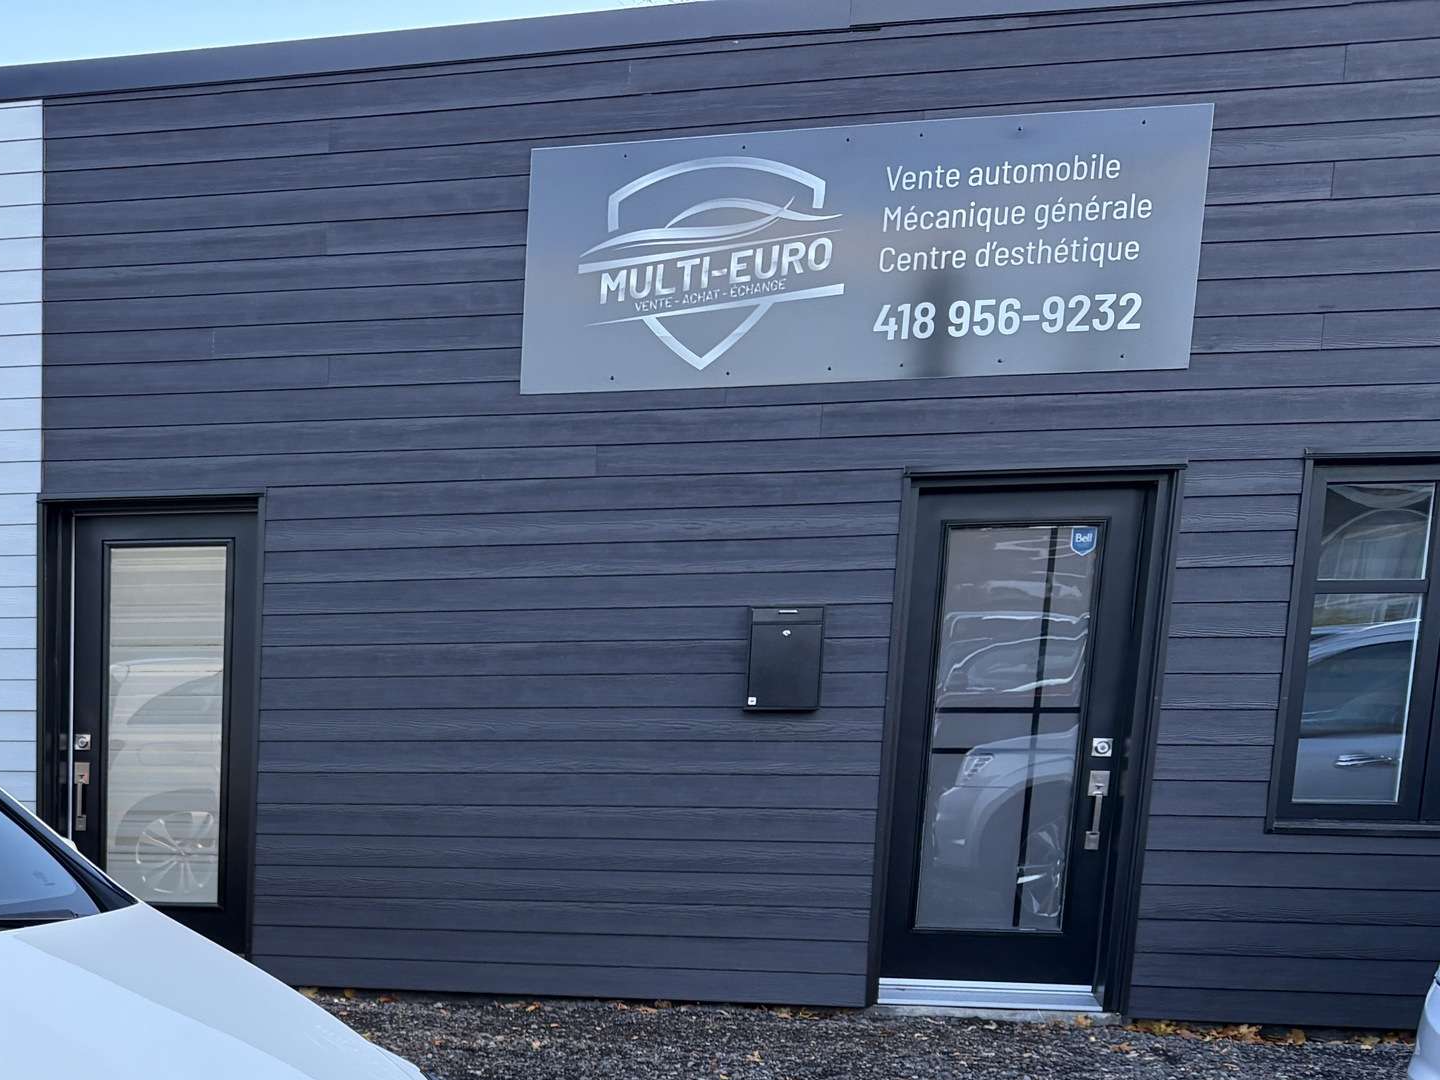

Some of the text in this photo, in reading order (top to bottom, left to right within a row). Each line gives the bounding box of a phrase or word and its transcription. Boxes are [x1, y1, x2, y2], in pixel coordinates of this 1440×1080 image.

[886, 153, 1121, 192] Vente automobile
[882, 193, 1152, 233] Mécanique générale
[599, 237, 833, 305] MULTI-EURO
[879, 236, 1140, 273] Centre d'esthétique
[634, 295, 672, 313] VENTE
[682, 288, 721, 305] ACHAT
[729, 278, 787, 298] ÉCHANGE
[872, 292, 1143, 341] 418 956-9232
[1075, 532, 1093, 543] Bell
